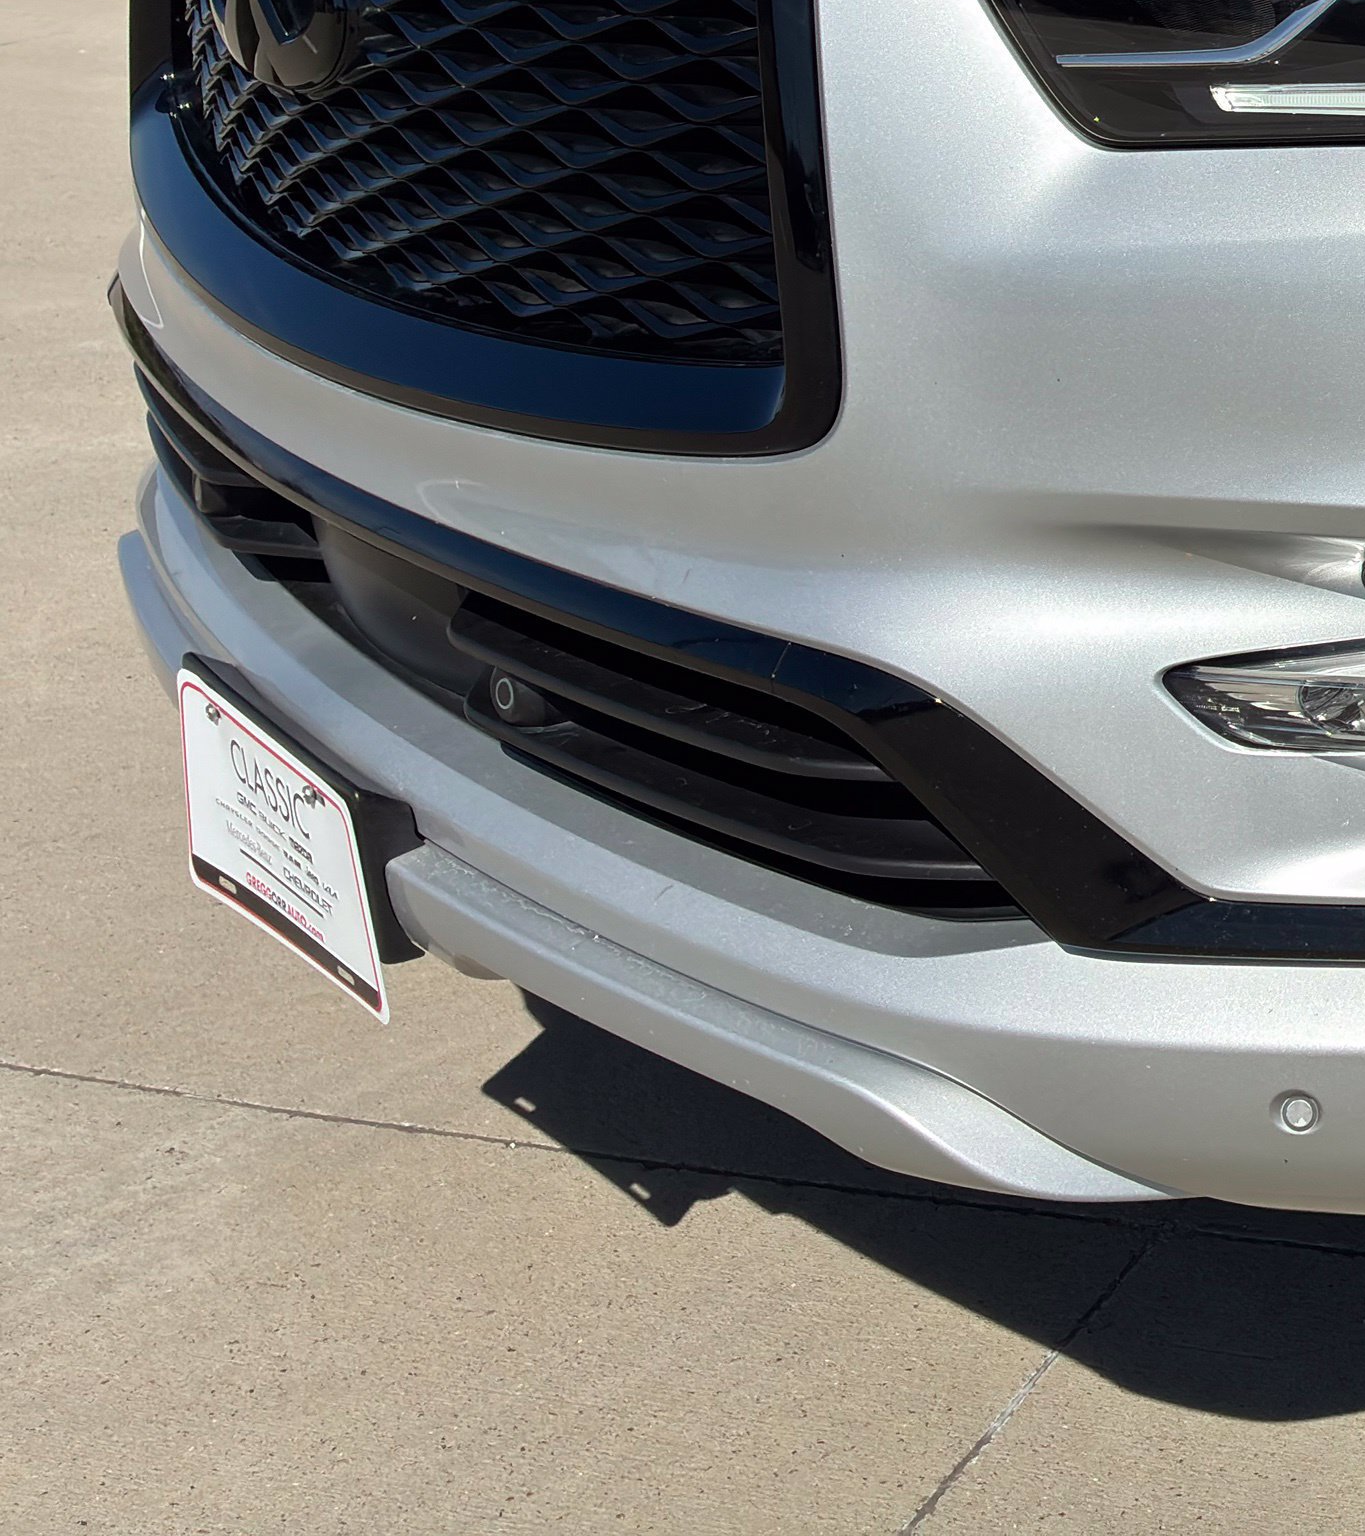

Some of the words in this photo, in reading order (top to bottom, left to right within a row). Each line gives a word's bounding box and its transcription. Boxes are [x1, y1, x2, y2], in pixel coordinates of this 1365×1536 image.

[230, 739, 311, 840] CLASSIC
[236, 791, 257, 816] GMC
[215, 797, 253, 827] CHRYSLER
[283, 866, 333, 917] CHEVROLET
